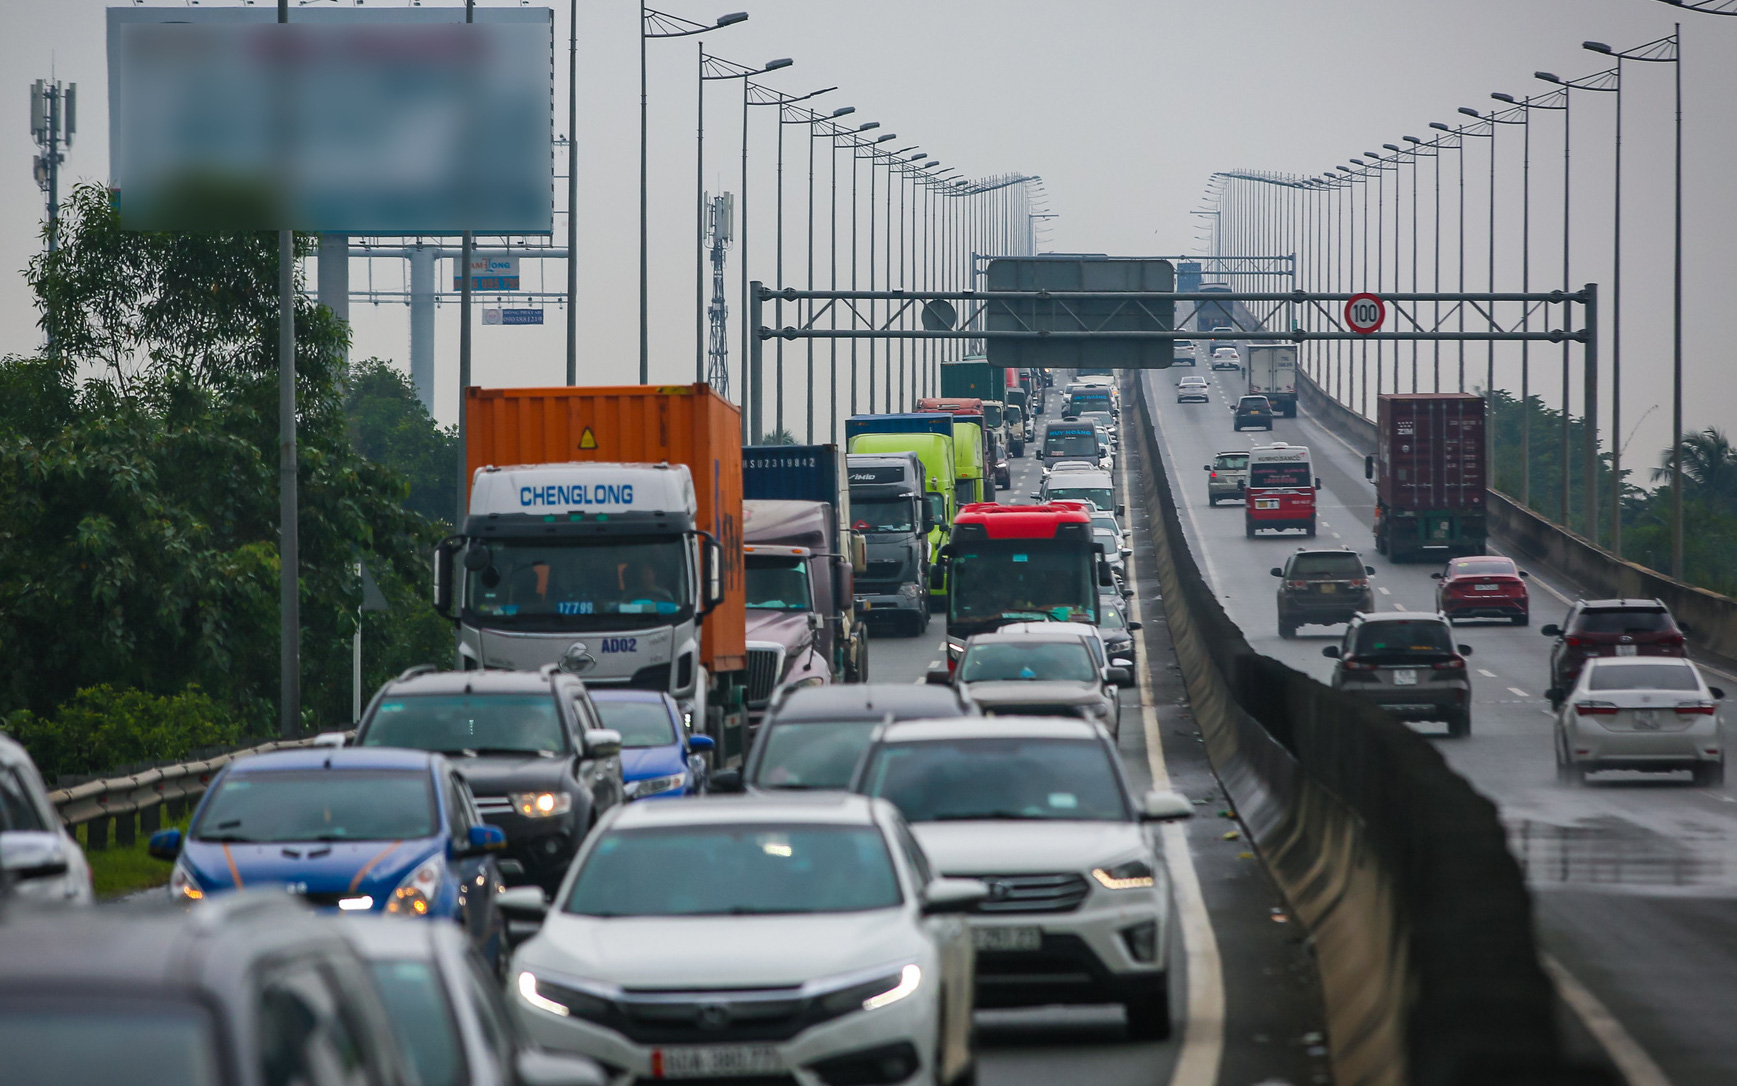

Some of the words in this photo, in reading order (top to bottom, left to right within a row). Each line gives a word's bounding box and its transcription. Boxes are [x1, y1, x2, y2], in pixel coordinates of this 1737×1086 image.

[1353, 304, 1377, 322] 100
[520, 484, 633, 507] CHENGLONG
[602, 638, 637, 653] AD02
